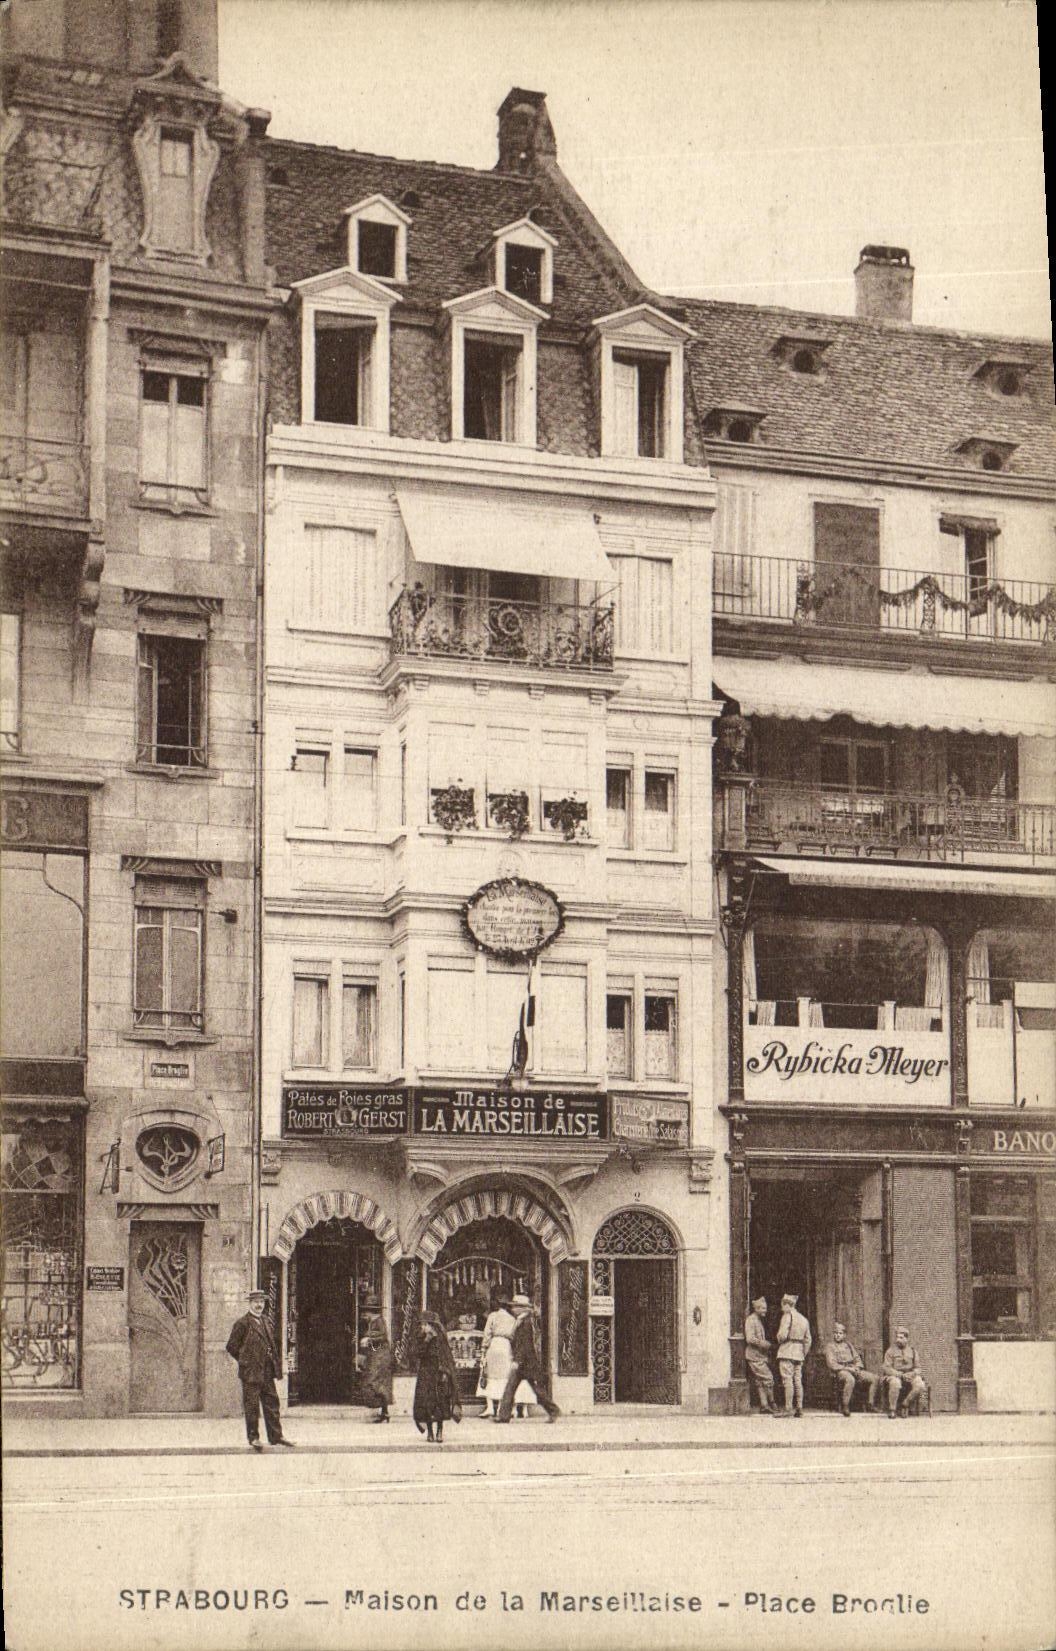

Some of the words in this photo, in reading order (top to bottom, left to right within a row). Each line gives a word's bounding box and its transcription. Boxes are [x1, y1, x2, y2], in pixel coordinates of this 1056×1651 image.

[288, 1090, 325, 1107] Pâtés
[327, 1096, 337, 1106] de
[338, 1089, 372, 1107] Foies
[374, 1093, 403, 1109] gras
[452, 1090, 536, 1109] Maison
[544, 1091, 566, 1109] de
[287, 1109, 334, 1129] ROBERT
[359, 1108, 406, 1129] GERST
[421, 1108, 448, 1132] LA
[452, 1109, 600, 1137] MARSEILLAISE
